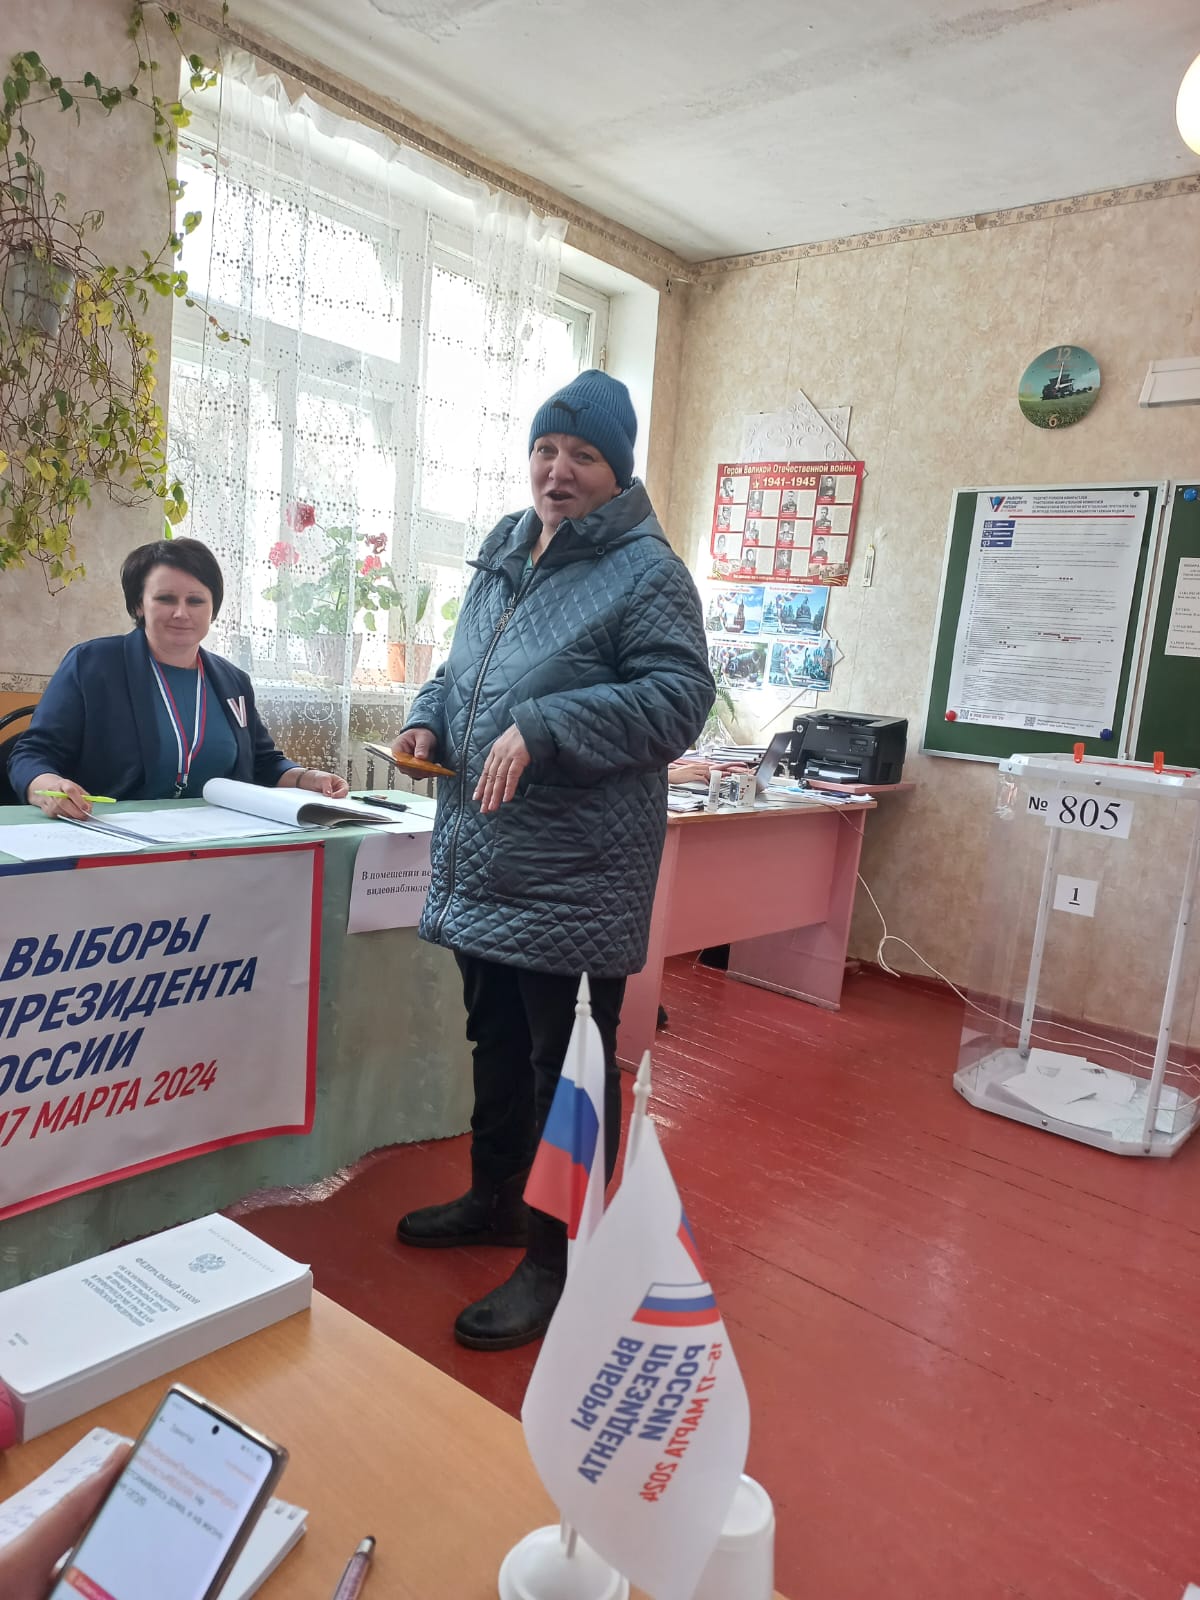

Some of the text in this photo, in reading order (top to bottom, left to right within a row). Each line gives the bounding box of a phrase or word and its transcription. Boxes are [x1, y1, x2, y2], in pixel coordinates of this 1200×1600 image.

[1049, 414, 1059, 428] 6
[1028, 795, 1121, 831] № 805
[361, 871, 368, 880] В
[366, 883, 430, 896] видеонаблюде
[0, 913, 211, 982] ВЫБОРЫ
[29, 1077, 144, 1140] МАРТА
[144, 1059, 218, 1108] 2024
